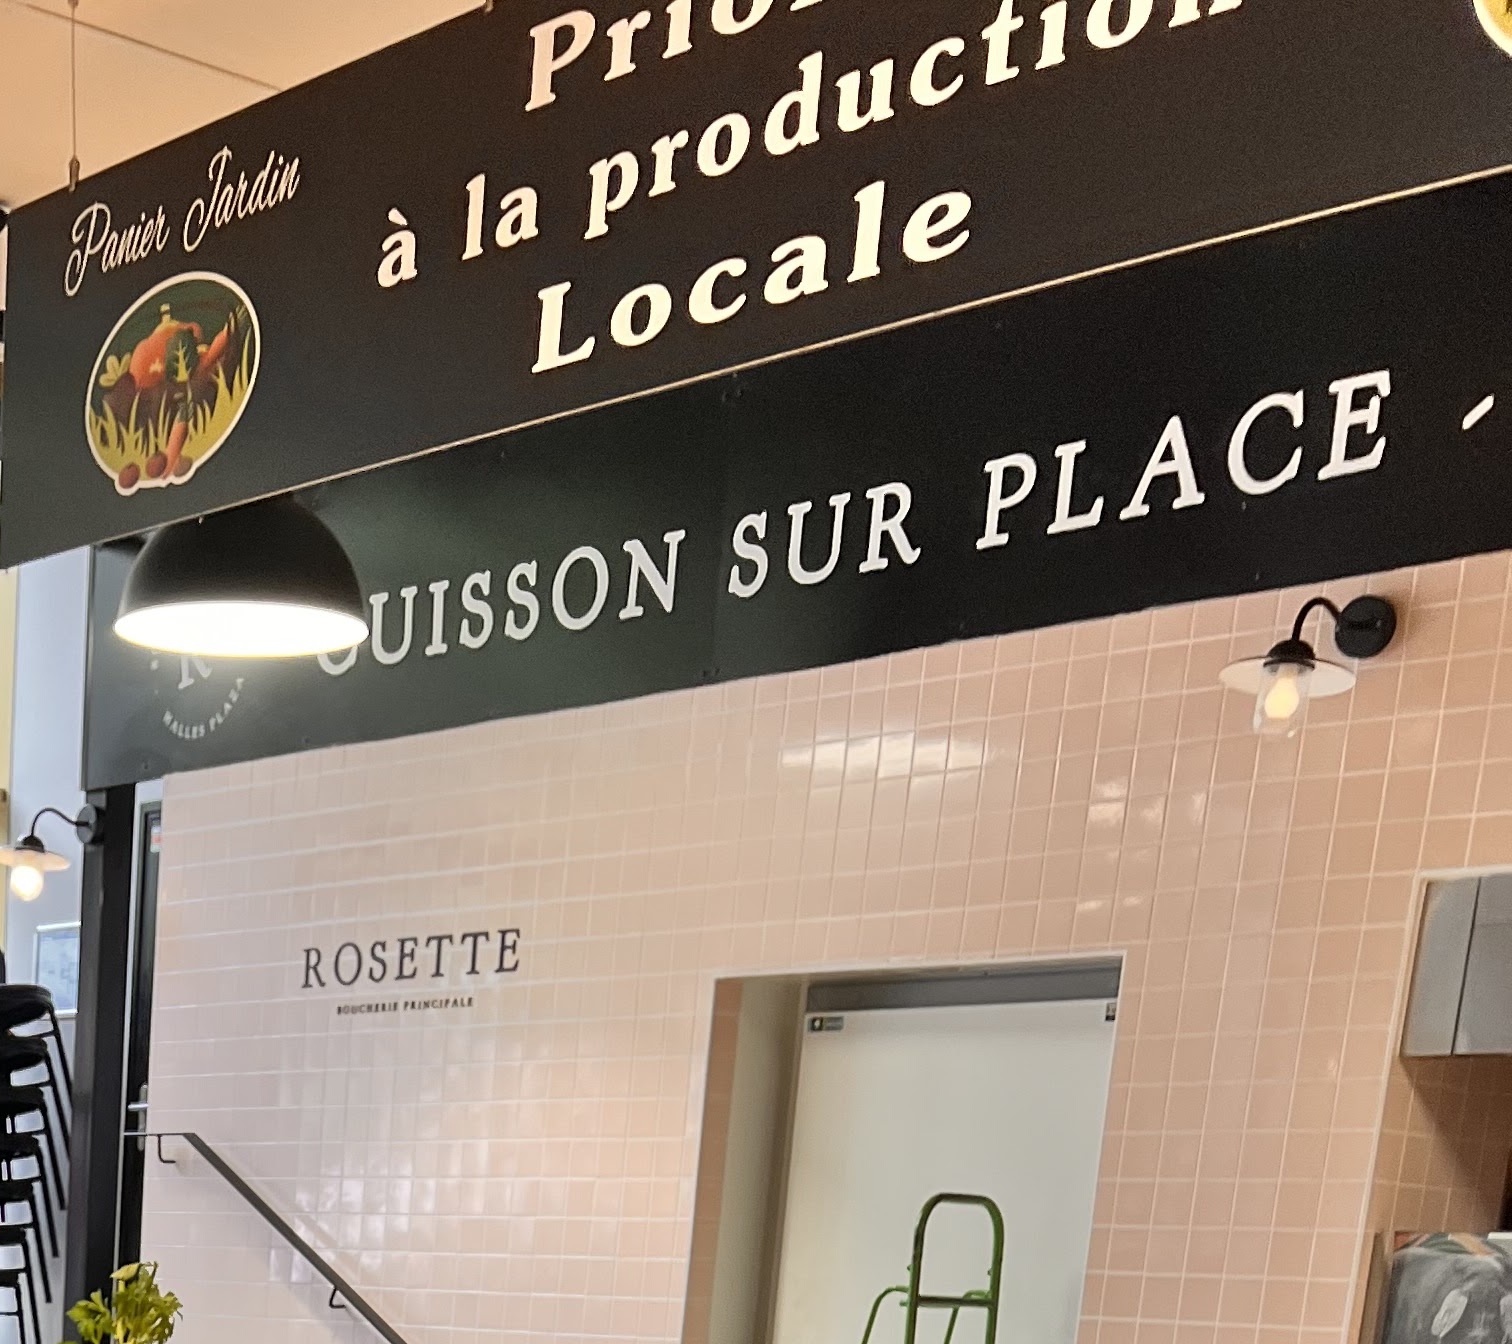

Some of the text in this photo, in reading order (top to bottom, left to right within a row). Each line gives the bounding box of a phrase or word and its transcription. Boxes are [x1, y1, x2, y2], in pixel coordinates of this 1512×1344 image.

[64, 145, 301, 297] Panier Jardin
[377, 207, 419, 288] à
[461, 172, 539, 261] la
[531, 180, 973, 375] Locale
[728, 481, 922, 599] SUR
[975, 368, 1392, 551] PLACE
[301, 928, 522, 990] ROSETTE
[336, 997, 475, 1016] BOUCHERIE PRINCIPALE
